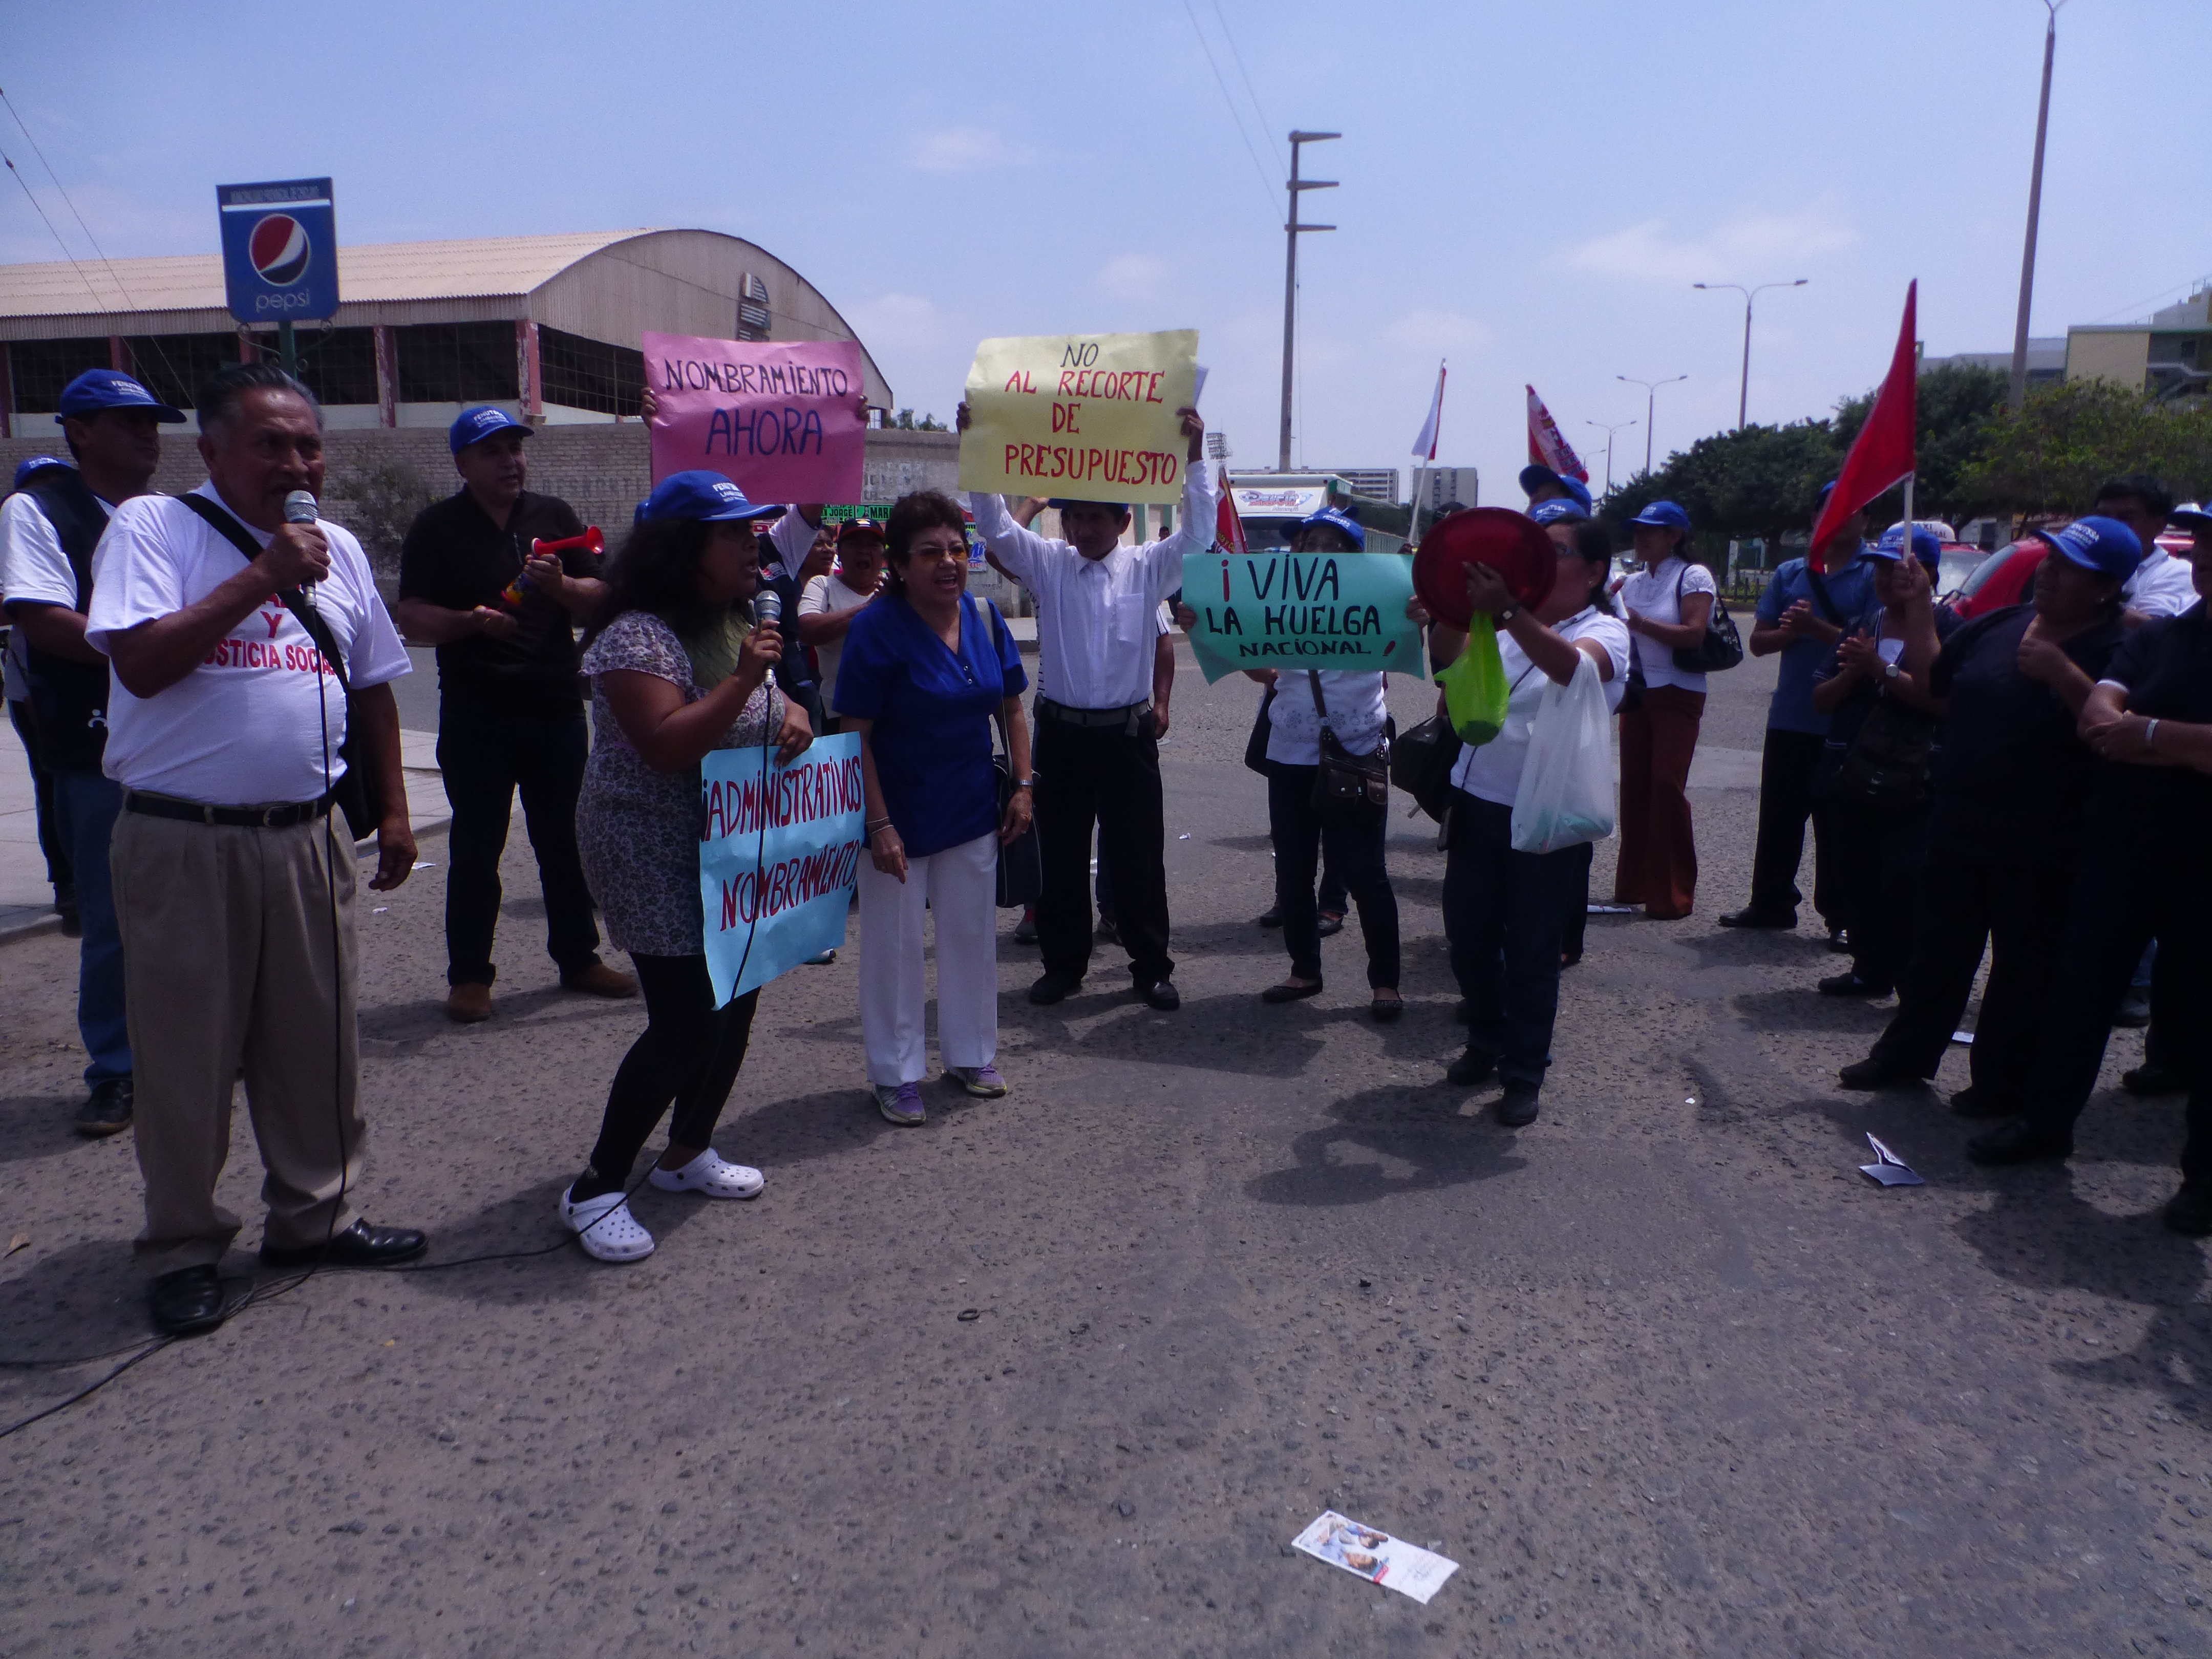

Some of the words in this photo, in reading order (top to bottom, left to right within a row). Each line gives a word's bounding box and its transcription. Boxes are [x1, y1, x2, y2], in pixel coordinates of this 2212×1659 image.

[256, 288, 309, 312] pepsi
[1060, 343, 1099, 367] NO
[1005, 370, 1037, 394] AL
[1058, 369, 1165, 404] RECORTE
[705, 408, 823, 456] AHORA
[1052, 402, 1081, 434] DE
[1005, 443, 1177, 485] PRESUPUESTO
[830, 508, 853, 517] JORGE
[260, 610, 283, 639] Y
[1205, 606, 1243, 635] LA
[1264, 604, 1381, 635] HUELGA
